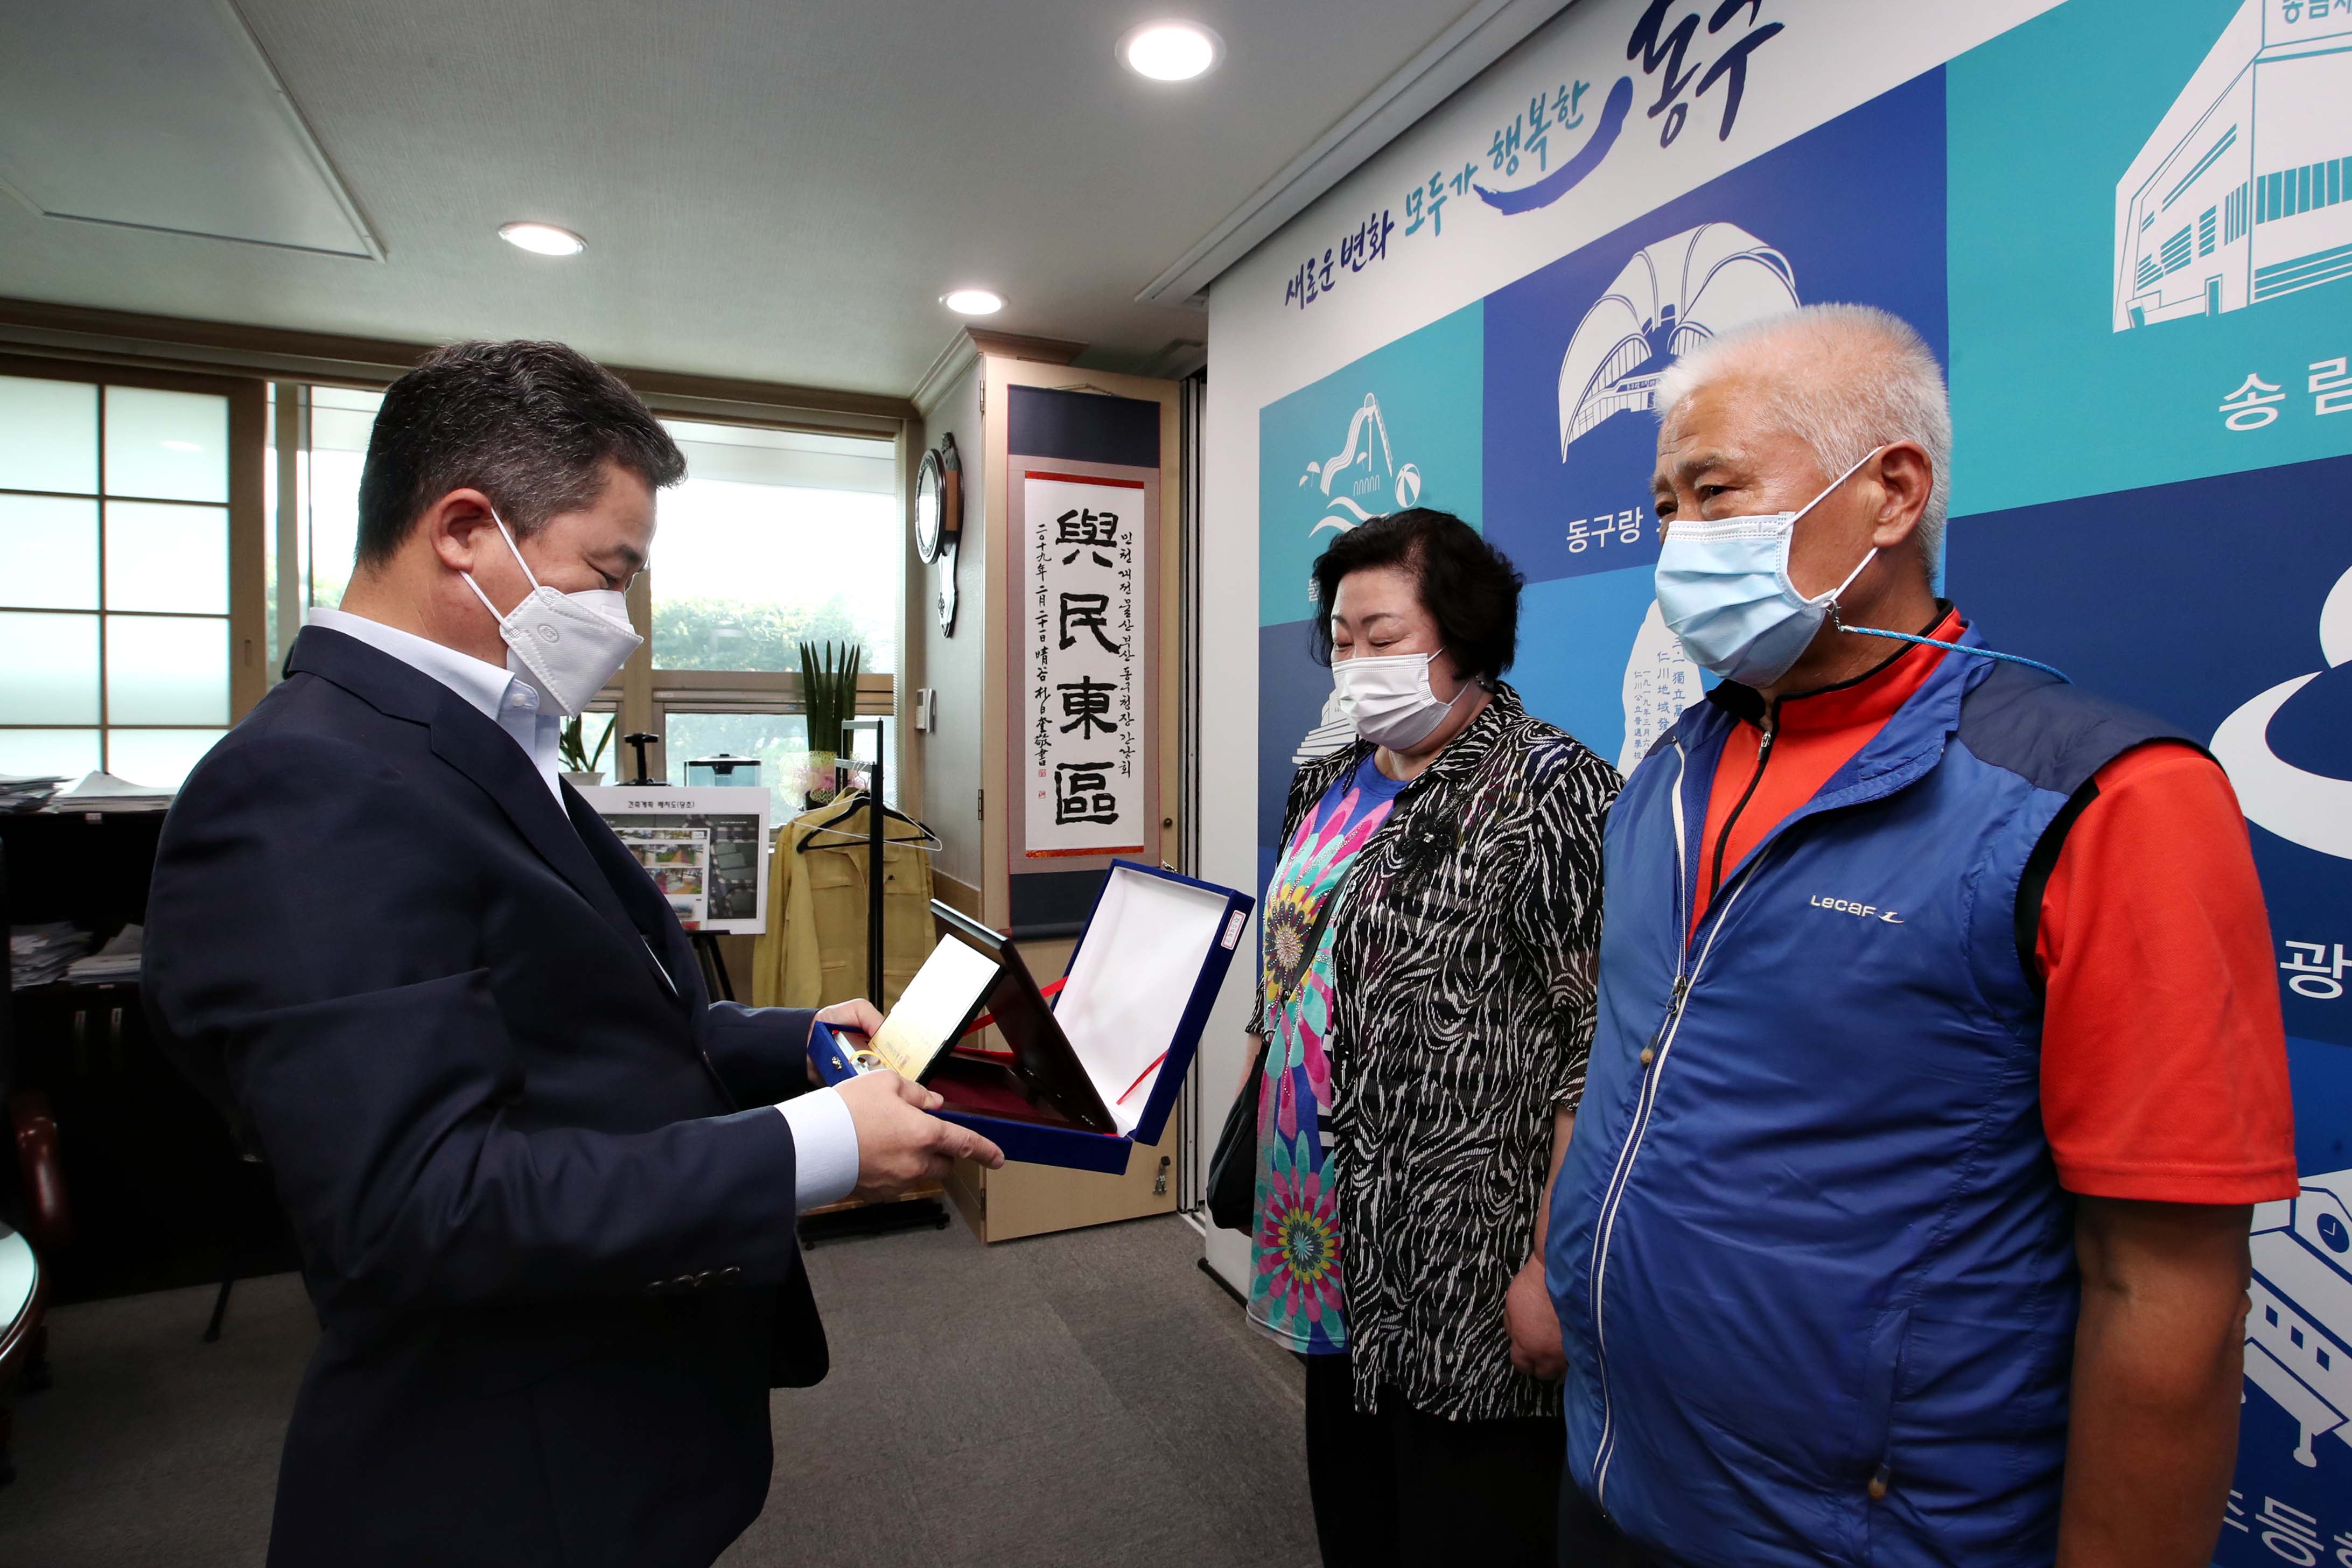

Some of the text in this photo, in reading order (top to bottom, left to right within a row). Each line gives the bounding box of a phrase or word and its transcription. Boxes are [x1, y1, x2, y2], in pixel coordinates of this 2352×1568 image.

[1285, 248, 1336, 310] 새로운
[1341, 209, 1395, 272] 변화
[1405, 162, 1479, 237] 모두가
[1487, 80, 1590, 177] 행복한
[1566, 506, 1644, 554] 동구랑
